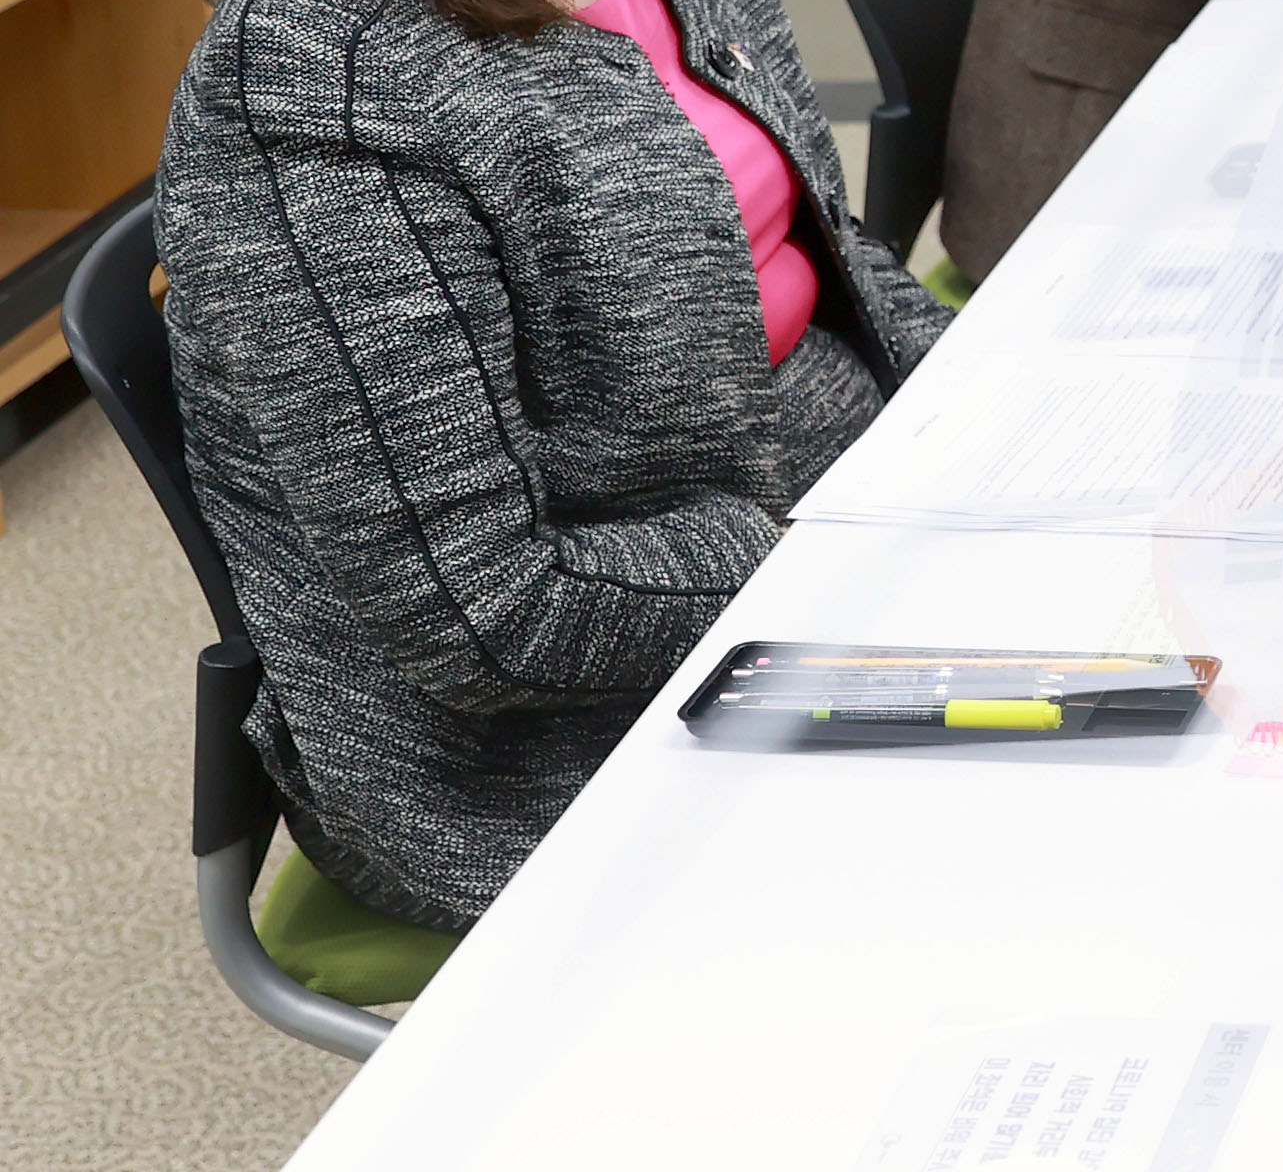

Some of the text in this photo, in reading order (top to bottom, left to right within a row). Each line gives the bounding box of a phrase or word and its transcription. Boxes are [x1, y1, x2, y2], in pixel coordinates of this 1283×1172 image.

[983, 1057, 1011, 1070] 이
[1020, 1061, 1057, 1088] 자리
[959, 1073, 1004, 1112] 좌석은
[1101, 1057, 1149, 1112] 코로나19
[1003, 1092, 1041, 1119] 띄어
[1033, 1074, 1095, 1158] 사회적 거리두
[943, 1117, 979, 1144] 비워
[1086, 1116, 1121, 1143] 집단
